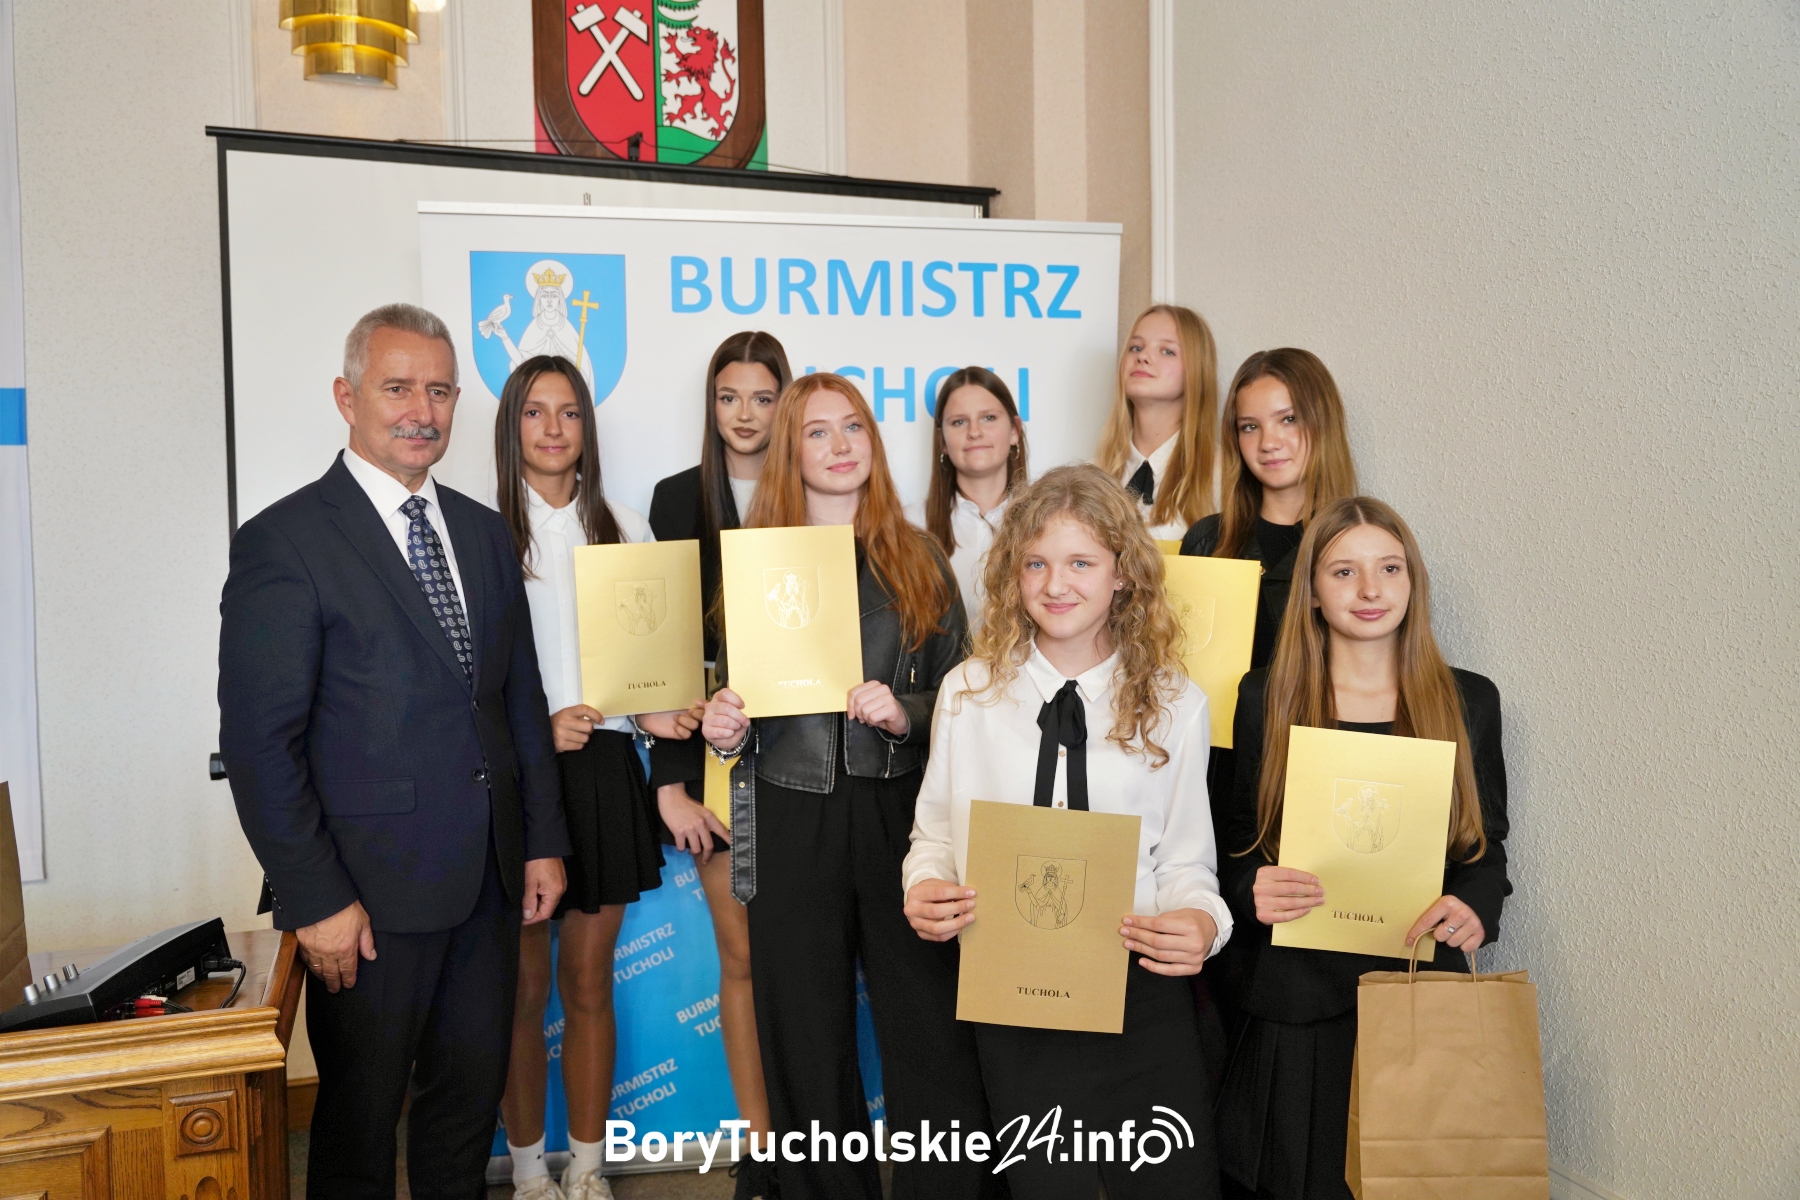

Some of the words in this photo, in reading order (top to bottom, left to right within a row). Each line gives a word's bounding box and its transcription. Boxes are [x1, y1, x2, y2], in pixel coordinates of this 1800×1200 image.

[670, 255, 1082, 319] BURMISTRZ
[626, 680, 667, 690] TUCHOLA
[777, 678, 821, 689] TUCHOLA
[1332, 910, 1385, 924] TUCHOLA
[1016, 986, 1071, 999] TUCHOLA
[614, 1082, 677, 1119] TUCHOLI
